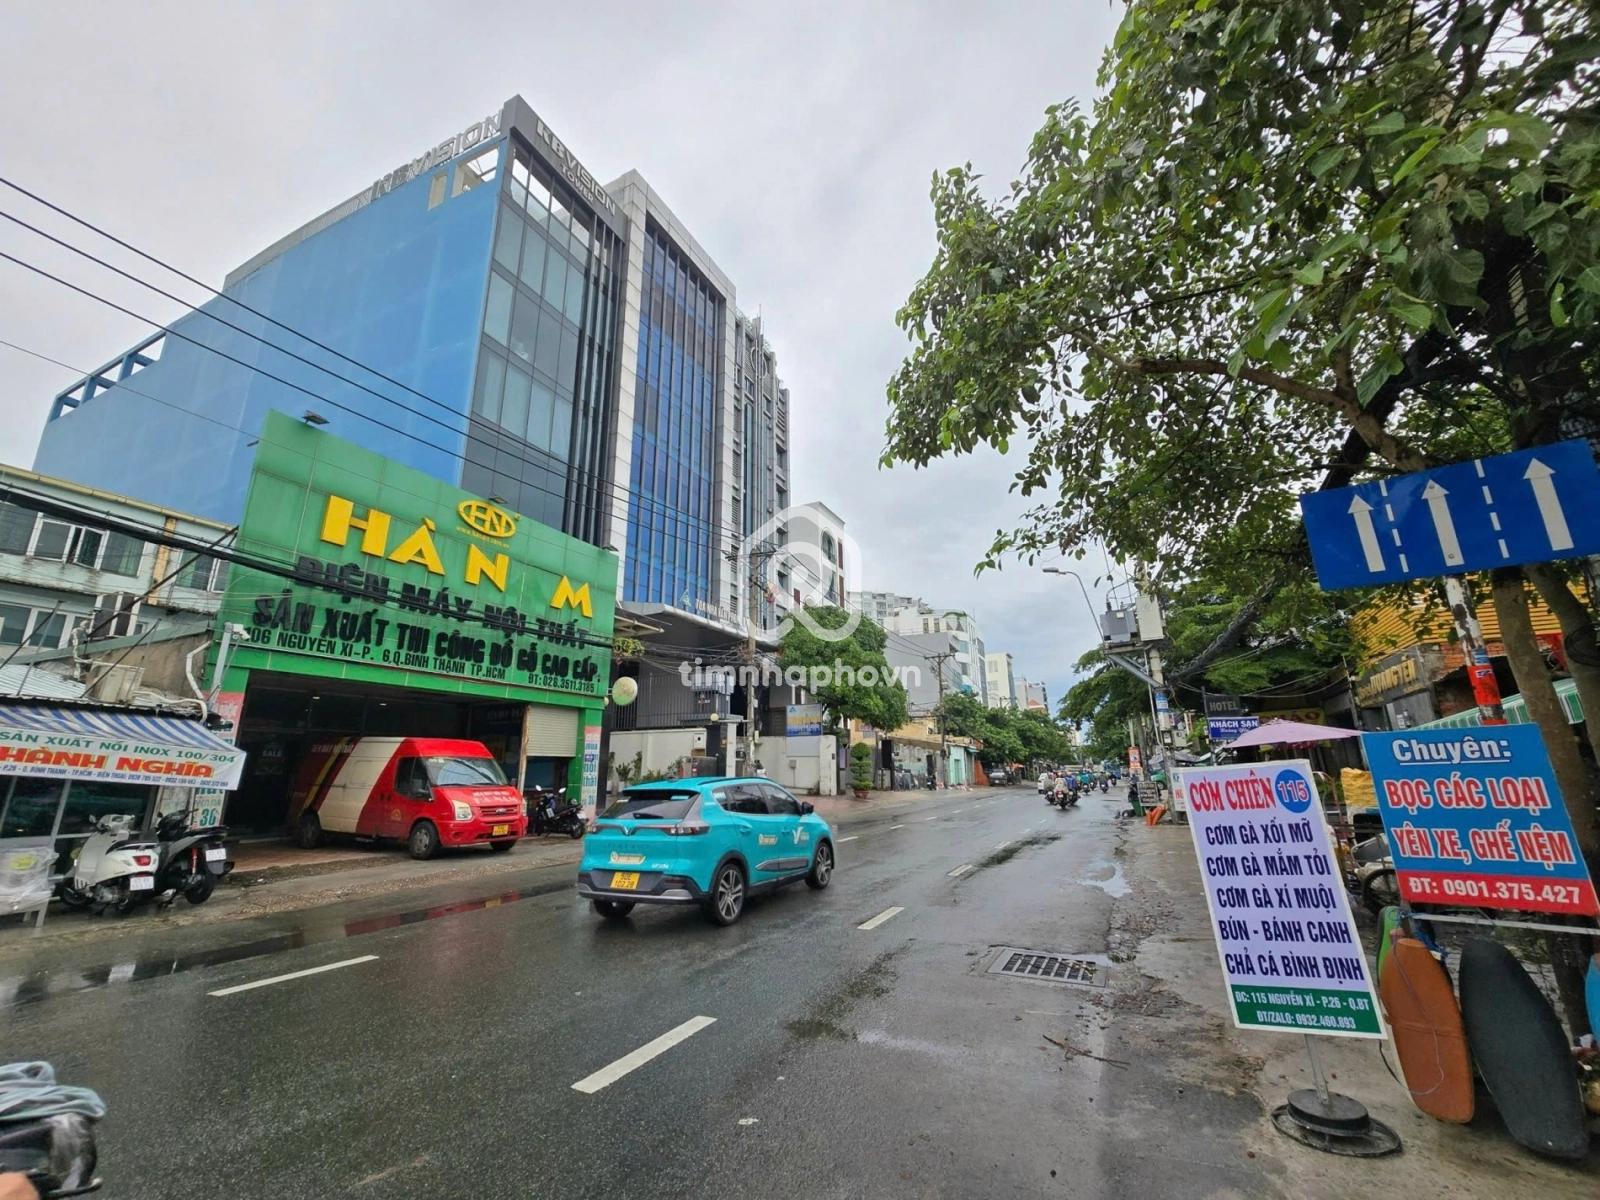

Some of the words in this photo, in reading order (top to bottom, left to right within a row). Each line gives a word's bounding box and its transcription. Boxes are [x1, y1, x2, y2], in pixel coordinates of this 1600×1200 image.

[536, 119, 616, 216] KBVISION
[561, 163, 594, 205] TOWER
[399, 583, 473, 621] MÁY
[253, 589, 316, 634] SẢN
[320, 608, 390, 647] XUẤT
[397, 622, 430, 654] THI
[435, 630, 486, 664] CÔNG
[541, 653, 570, 678] CAO
[433, 657, 465, 673] THẠNH
[470, 663, 506, 680] TP.HCM
[1210, 702, 1239, 712] HOTEL
[1210, 719, 1239, 728] KHÁCH
[1241, 720, 1258, 729] SẠN
[0, 730, 39, 743] SẢN
[44, 737, 93, 748] XUẤT
[133, 745, 171, 757] INOX
[176, 750, 236, 763] 100/304
[1391, 736, 1513, 764] Chuyên:
[115, 755, 214, 778] NGHĨA
[1189, 777, 1225, 812] CƠM
[1225, 770, 1277, 811] CHIÊN
[1278, 781, 1309, 802] 115
[1384, 779, 1433, 815] BỌC
[1434, 772, 1487, 809] CÁC
[1485, 777, 1552, 816] LOẠI
[1205, 824, 1235, 846] CƠM
[1239, 820, 1260, 845] GÀ
[1260, 817, 1289, 844] XỐI
[1290, 818, 1314, 842] MỠ
[1391, 821, 1433, 858] YÊN
[1432, 828, 1472, 864] XE,
[1469, 820, 1519, 861] GHẾ
[1515, 823, 1577, 870] NỆM
[1206, 855, 1240, 877] CƠM
[1241, 852, 1262, 876] GÀ
[1264, 847, 1303, 876] MẮM
[1303, 847, 1331, 875] TỎI
[1216, 886, 1250, 908] CƠM
[1251, 883, 1274, 908] GÀ
[1274, 884, 1294, 908] XÍ
[1296, 884, 1337, 913] MUỘI
[1408, 876, 1439, 894] ĐT:
[1443, 878, 1580, 904] 0901.375.427
[1219, 916, 1251, 941] BÚN
[1261, 916, 1306, 942] BÁNH
[1307, 921, 1352, 944] CANH
[1224, 947, 1257, 975] CHẢ
[1258, 949, 1280, 976] CÁ
[1282, 951, 1322, 979] BÌNH
[1323, 956, 1365, 984] ĐỊNH
[1251, 992, 1267, 1004] 115
[1321, 996, 1341, 1009] P.26
[1348, 998, 1370, 1011] Q.BT
